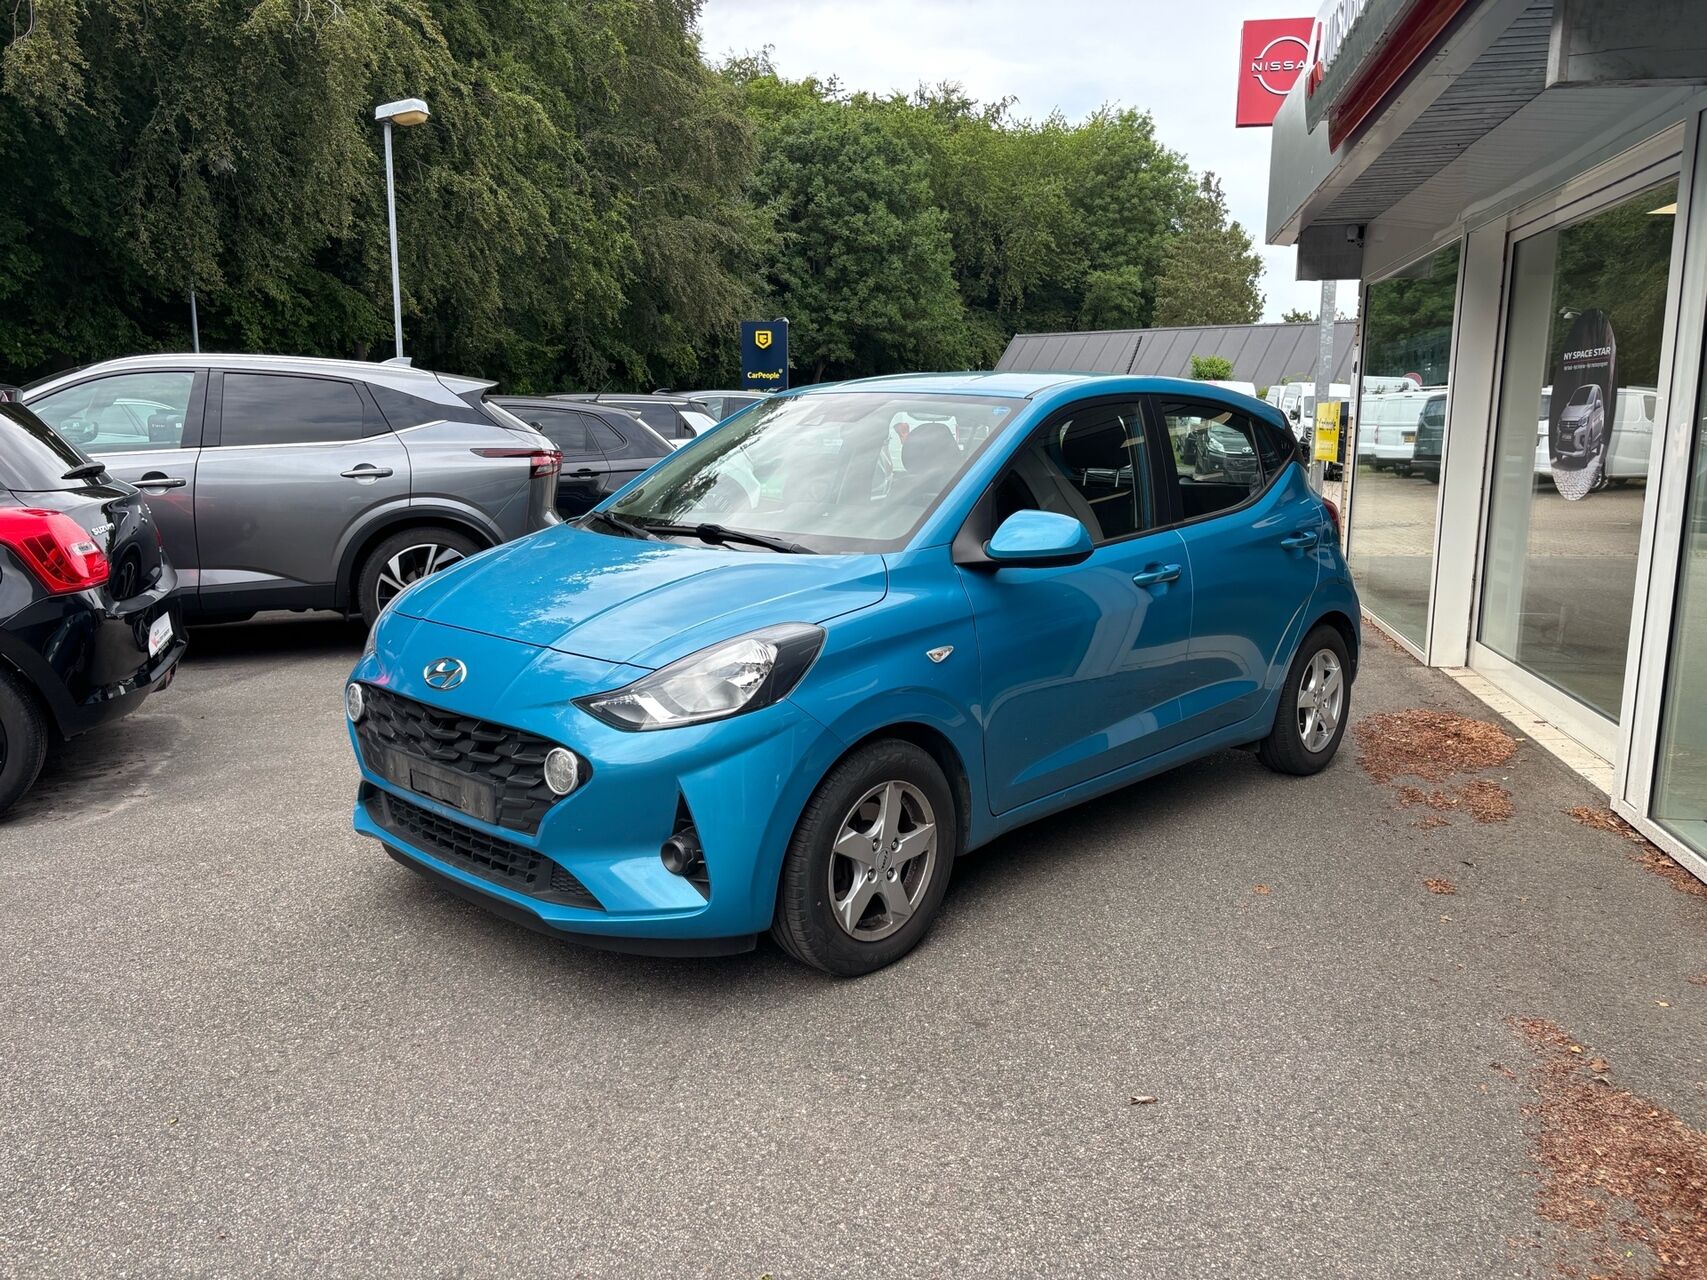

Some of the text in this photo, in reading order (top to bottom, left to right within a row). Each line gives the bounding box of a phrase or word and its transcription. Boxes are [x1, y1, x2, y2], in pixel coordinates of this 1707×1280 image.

[1251, 60, 1306, 72] NISSA
[1563, 347, 1611, 361] NY SPACE STAR
[747, 372, 780, 380] CarPeople
